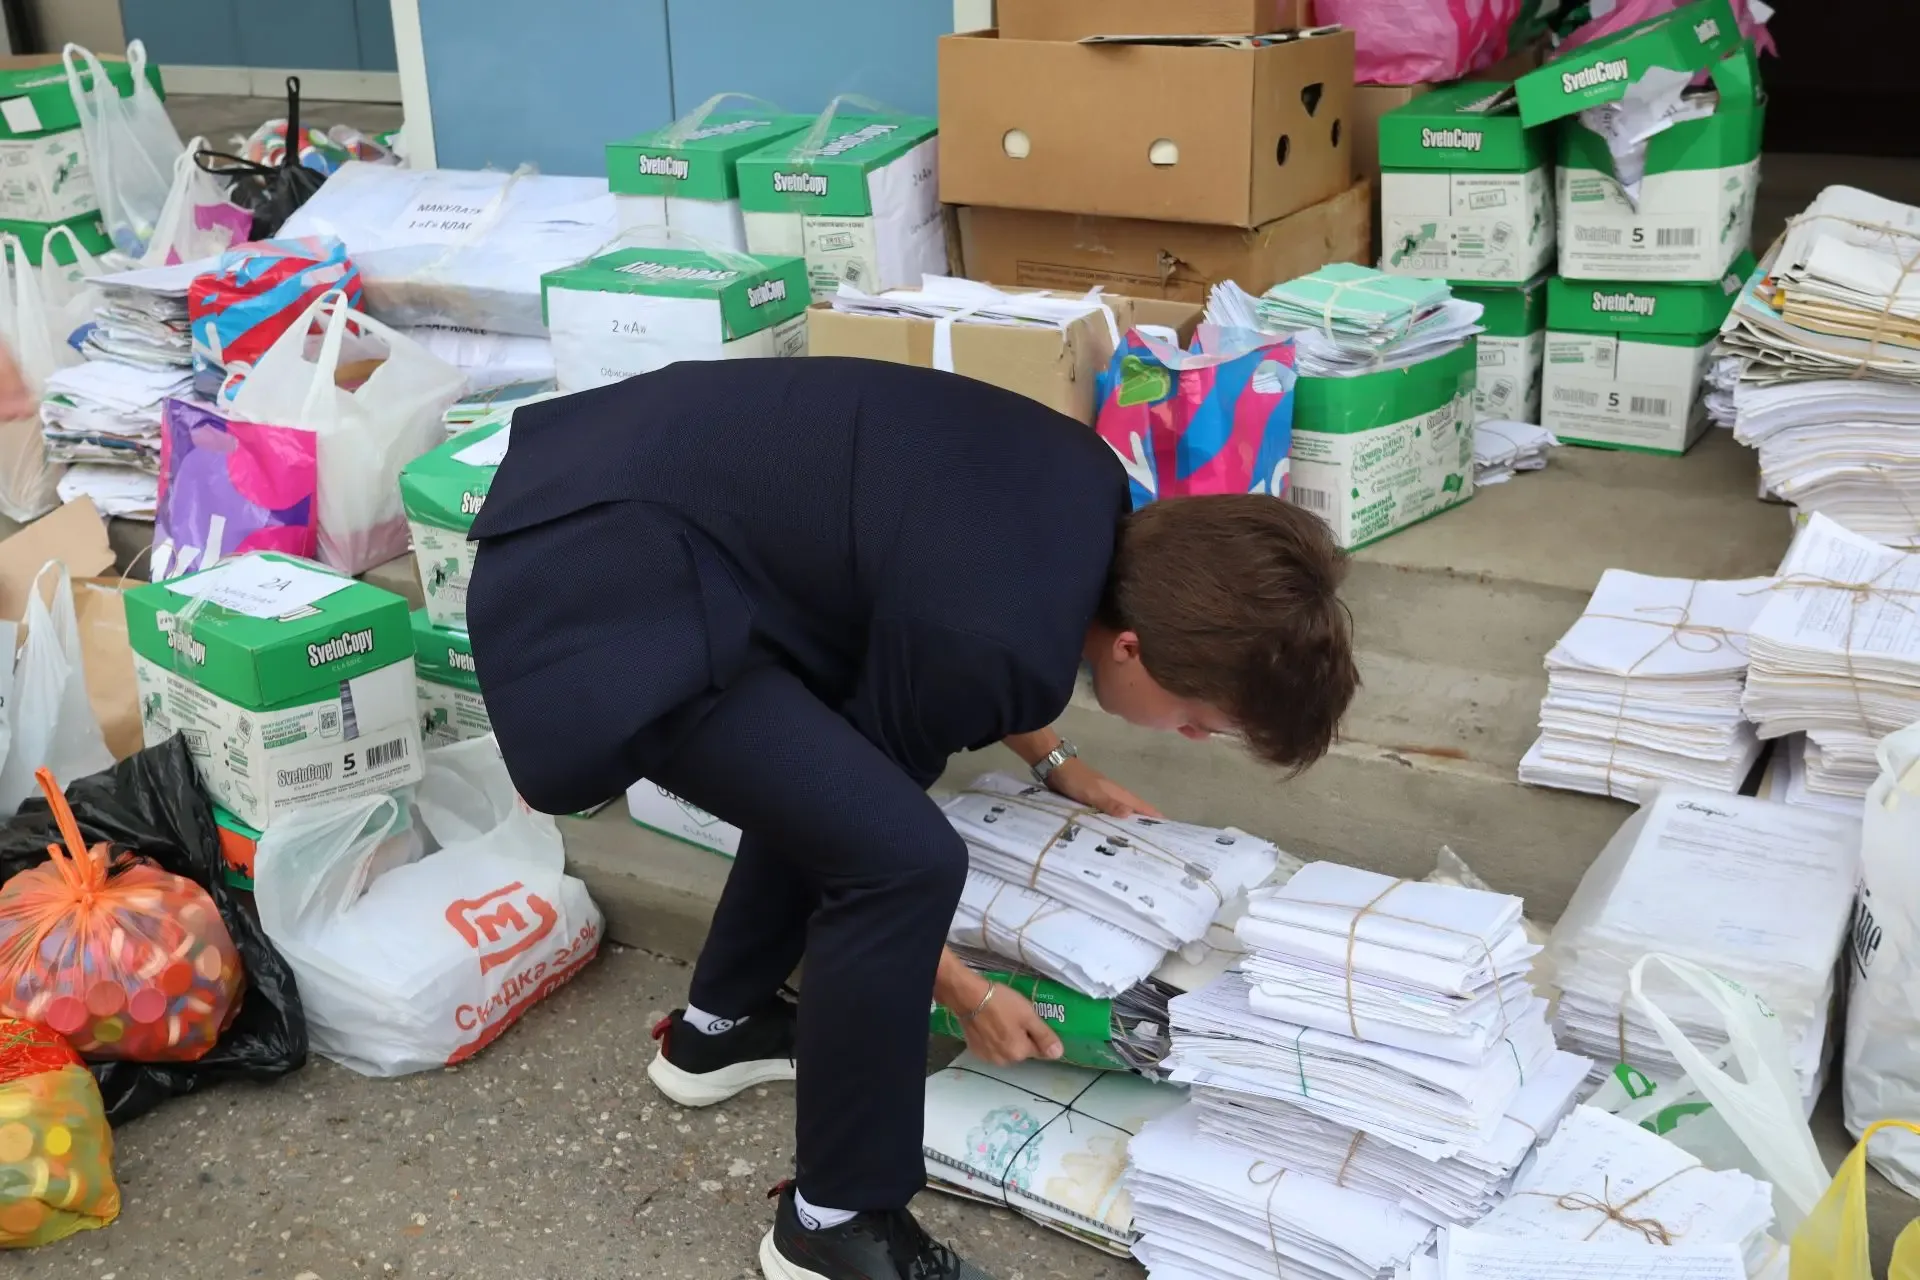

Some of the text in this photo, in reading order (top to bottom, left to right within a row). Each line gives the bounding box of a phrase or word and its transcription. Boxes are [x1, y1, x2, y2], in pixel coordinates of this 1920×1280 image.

[1562, 57, 1628, 94] SvetoCopy
[1422, 127, 1483, 151] SvetoCopy
[639, 154, 689, 180] SvetoCopy
[773, 170, 828, 196] SvetoCopy
[1632, 228, 1645, 243] 5
[747, 278, 787, 309] SvetoCopy
[1592, 291, 1656, 316] SvetoCopy
[611, 320, 647, 335] 2 «А»
[1608, 392, 1620, 407] 5
[307, 627, 375, 668] SvetoCopy
[448, 647, 476, 672] Sveto
[331, 657, 363, 672] CLASSIC
[277, 762, 333, 787] SvetoCopy
[343, 752, 356, 771] 5
